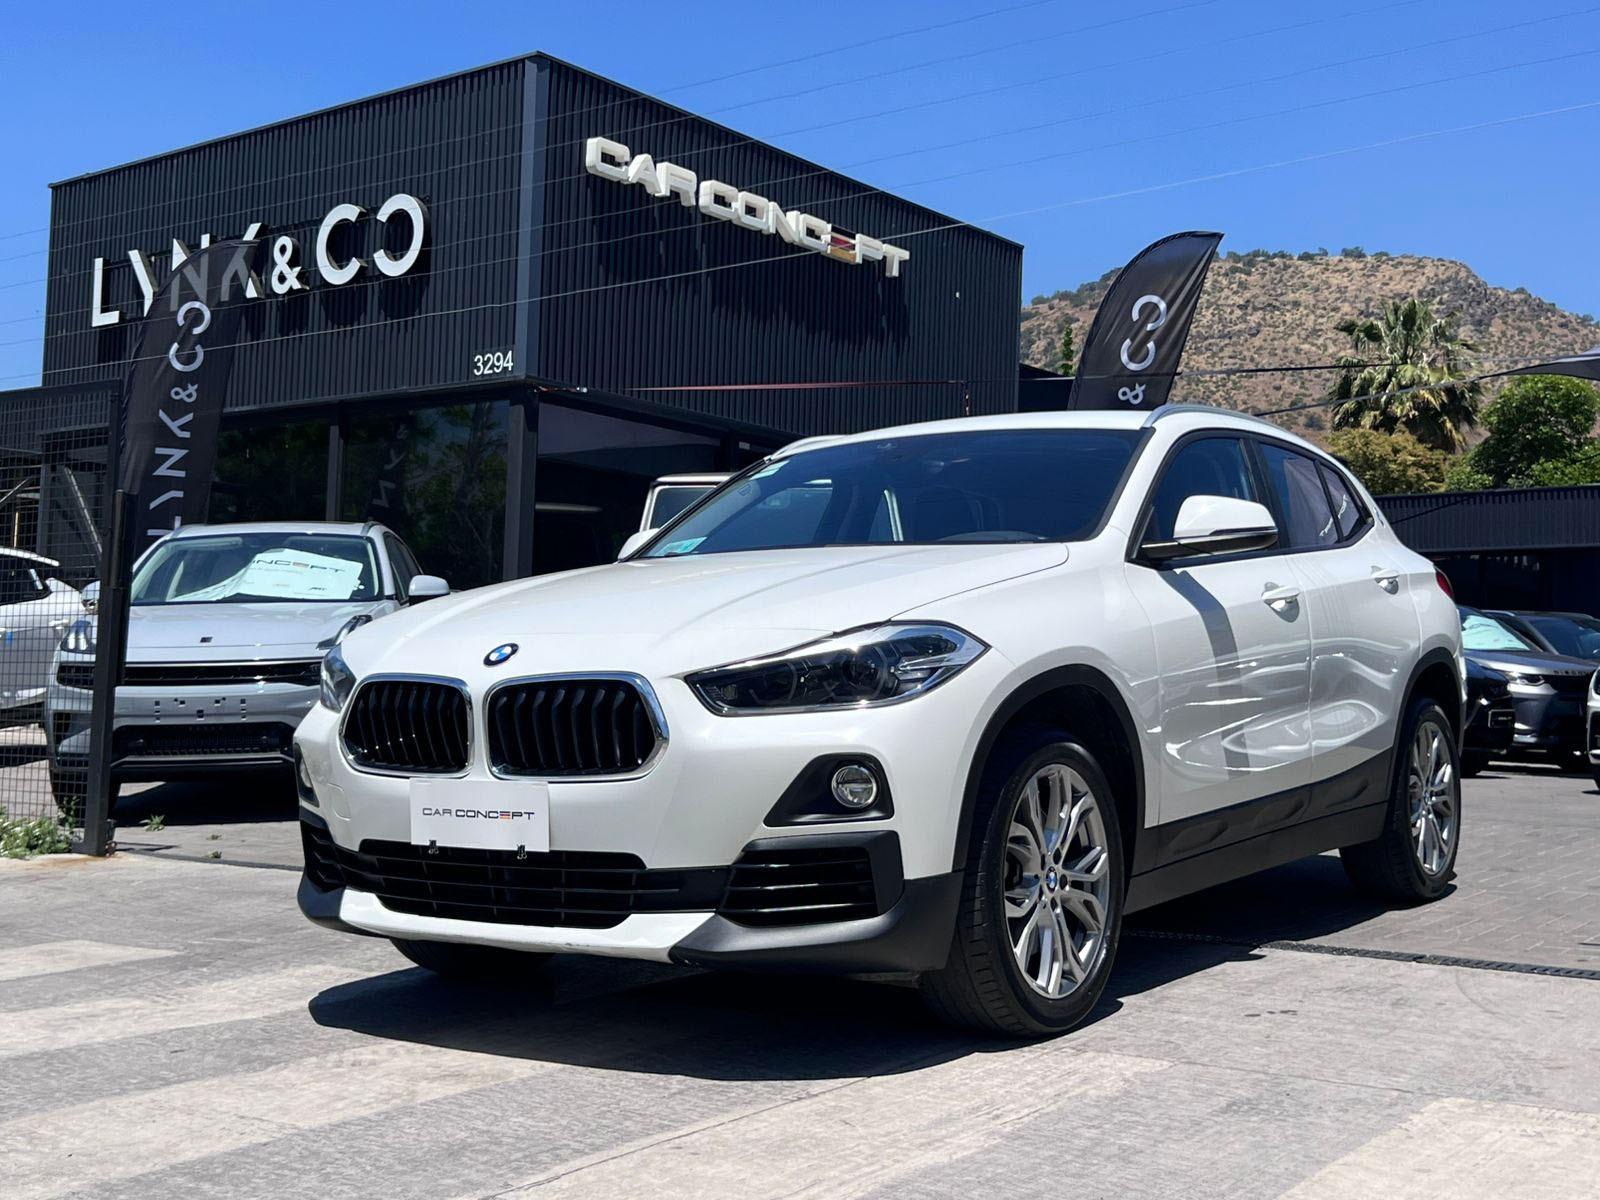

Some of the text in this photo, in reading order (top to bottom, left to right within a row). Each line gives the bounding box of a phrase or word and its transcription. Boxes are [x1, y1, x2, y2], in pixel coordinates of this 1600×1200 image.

[586, 137, 909, 277] CAR CONCEPT
[473, 350, 514, 376] 3294
[422, 808, 535, 820] CAR CONCEPT
